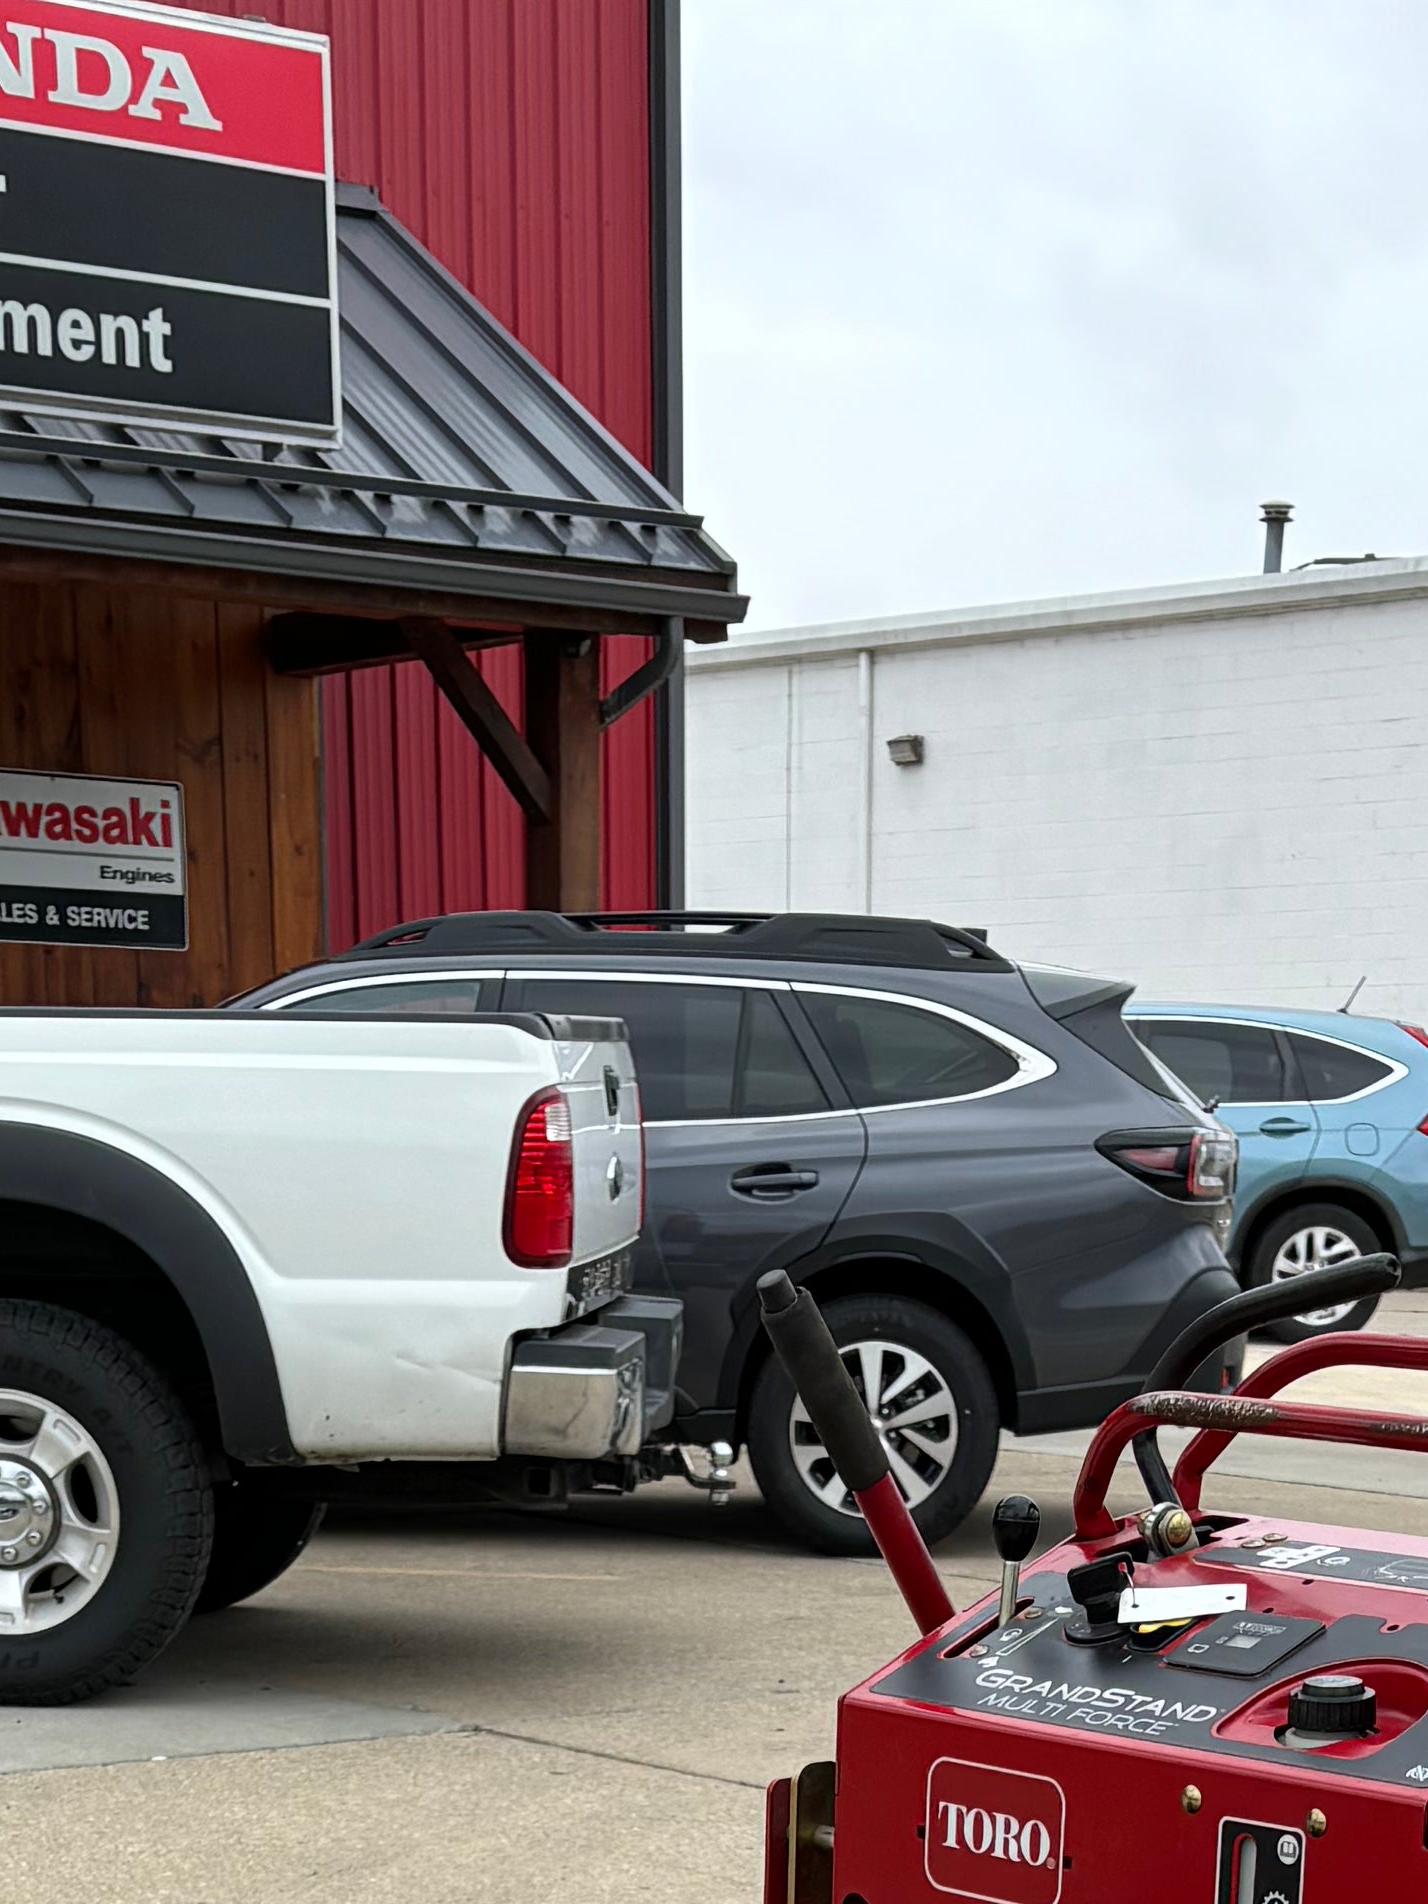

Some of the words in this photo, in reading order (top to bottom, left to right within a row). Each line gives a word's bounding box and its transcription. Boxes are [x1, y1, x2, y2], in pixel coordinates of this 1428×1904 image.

[100, 865, 175, 884] Engines
[45, 906, 59, 926] &
[66, 906, 149, 930] SERVICE
[977, 1693, 1067, 1716] MULTI
[1066, 1708, 1173, 1736] FORCE
[938, 1801, 1050, 1866] TORO
